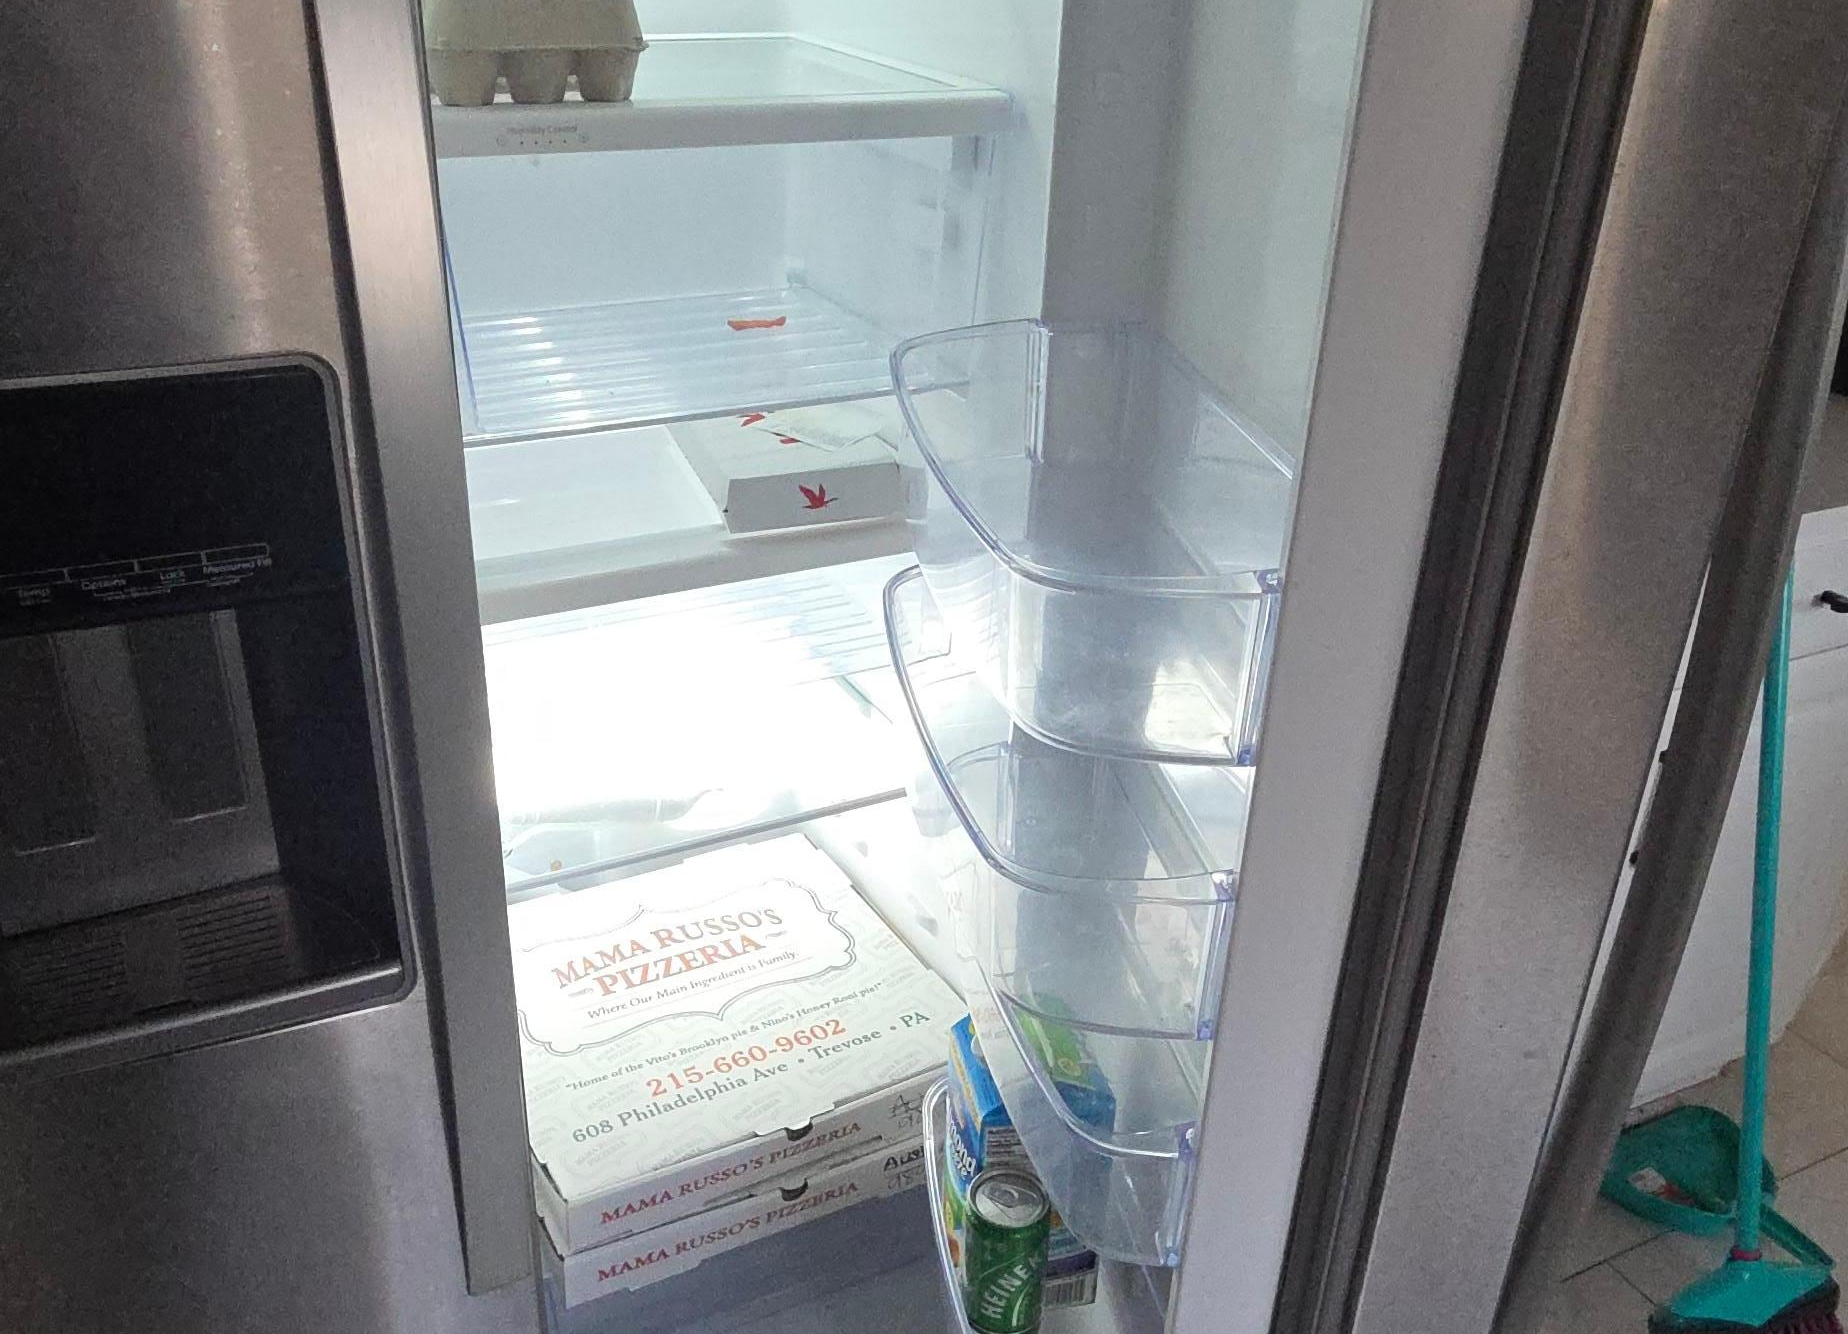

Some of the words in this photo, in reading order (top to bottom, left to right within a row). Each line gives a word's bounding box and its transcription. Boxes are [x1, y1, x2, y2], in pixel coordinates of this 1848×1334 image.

[552, 939, 652, 989] MAMA
[650, 908, 783, 950] RUSSO'S
[592, 934, 767, 997] PIZZERIA
[588, 1003, 628, 1019] Where
[629, 995, 653, 1007] Our
[656, 986, 688, 1000] Main
[690, 967, 746, 988] Ingredient
[572, 1119, 614, 1143] 608
[617, 1076, 749, 1127] Philadelphia
[752, 1063, 789, 1082] Ave
[807, 1029, 883, 1060] Trevose
[899, 1011, 931, 1028] PA
[611, 1066, 624, 1078] of
[625, 1062, 645, 1074] the
[645, 1051, 677, 1066] Vito's
[679, 1034, 730, 1056] Brooklyn
[731, 1028, 749, 1042] pie
[750, 1024, 760, 1033] &
[761, 1013, 795, 1028] Nino's
[797, 1001, 831, 1018] Honey
[645, 1018, 847, 1098] 215-660-9602
[600, 1189, 674, 1224] MAMA
[677, 1155, 764, 1198] RUSSO'S
[768, 1122, 862, 1165] PIZZERIA
[598, 1247, 671, 1283] MAMA
[674, 1215, 762, 1256] RUSSO'S
[765, 1181, 860, 1223] PIZZERIA
